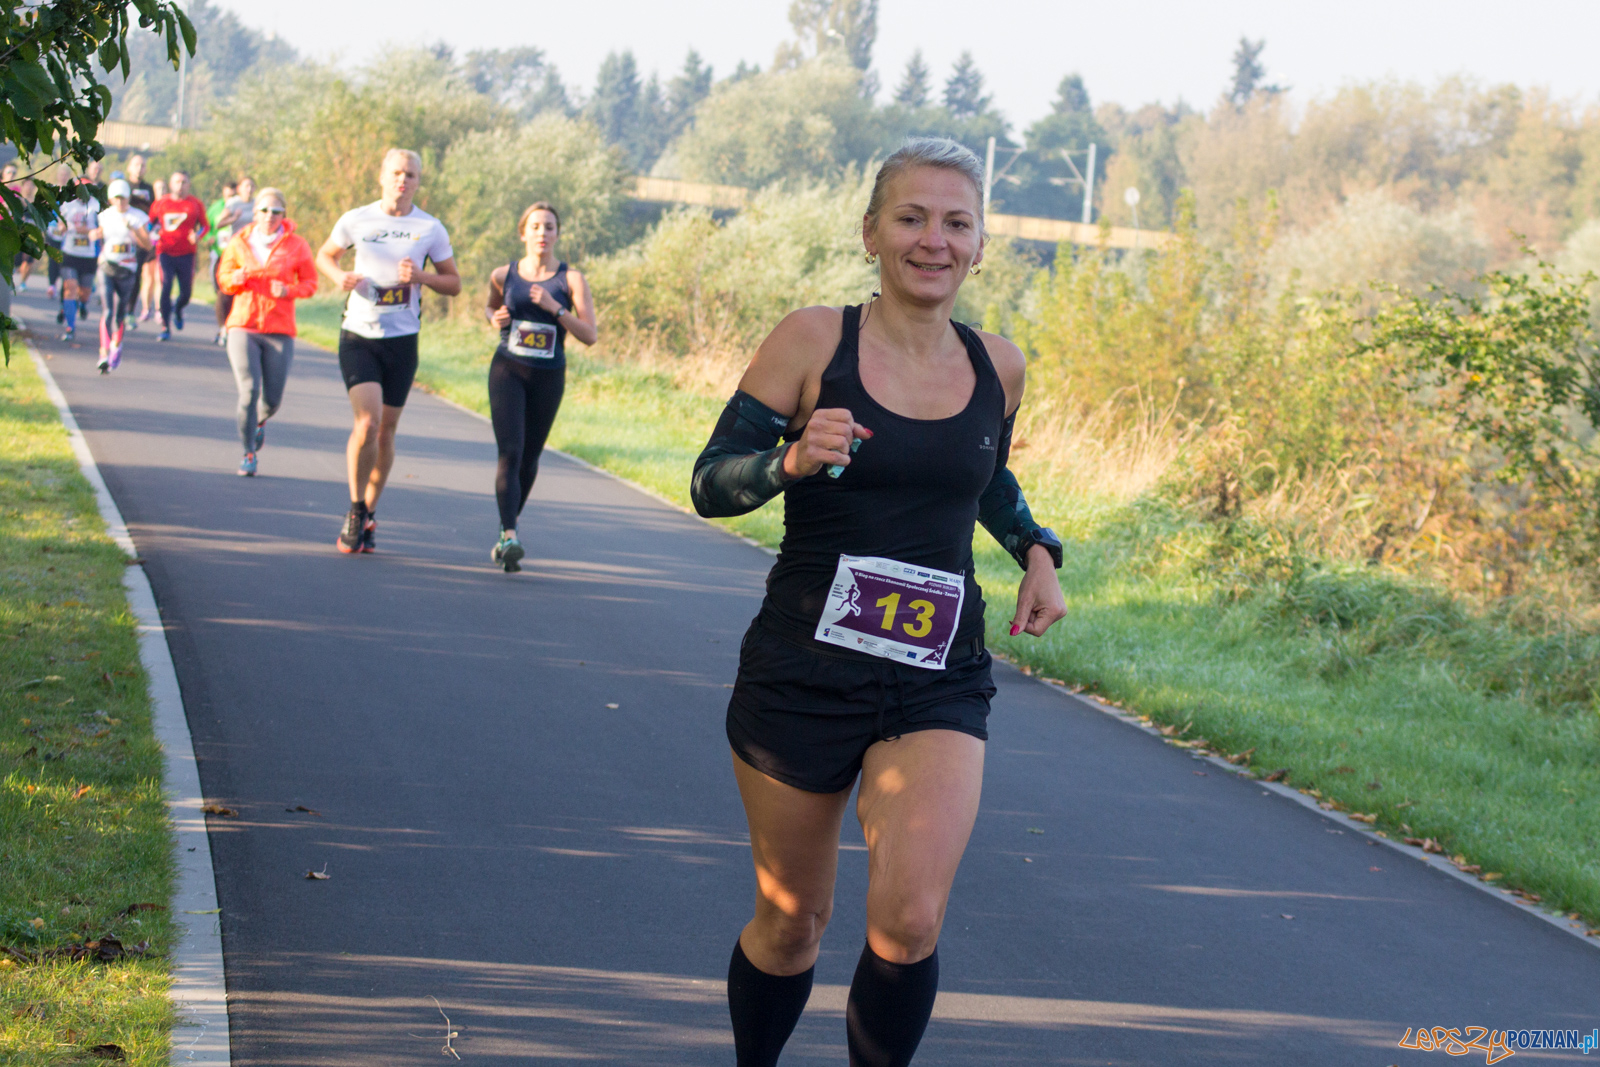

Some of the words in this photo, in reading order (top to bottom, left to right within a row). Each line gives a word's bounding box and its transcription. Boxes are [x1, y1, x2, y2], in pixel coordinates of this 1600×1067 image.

[382, 289, 403, 304] 41
[523, 333, 547, 348] 43
[875, 592, 936, 638] 13
